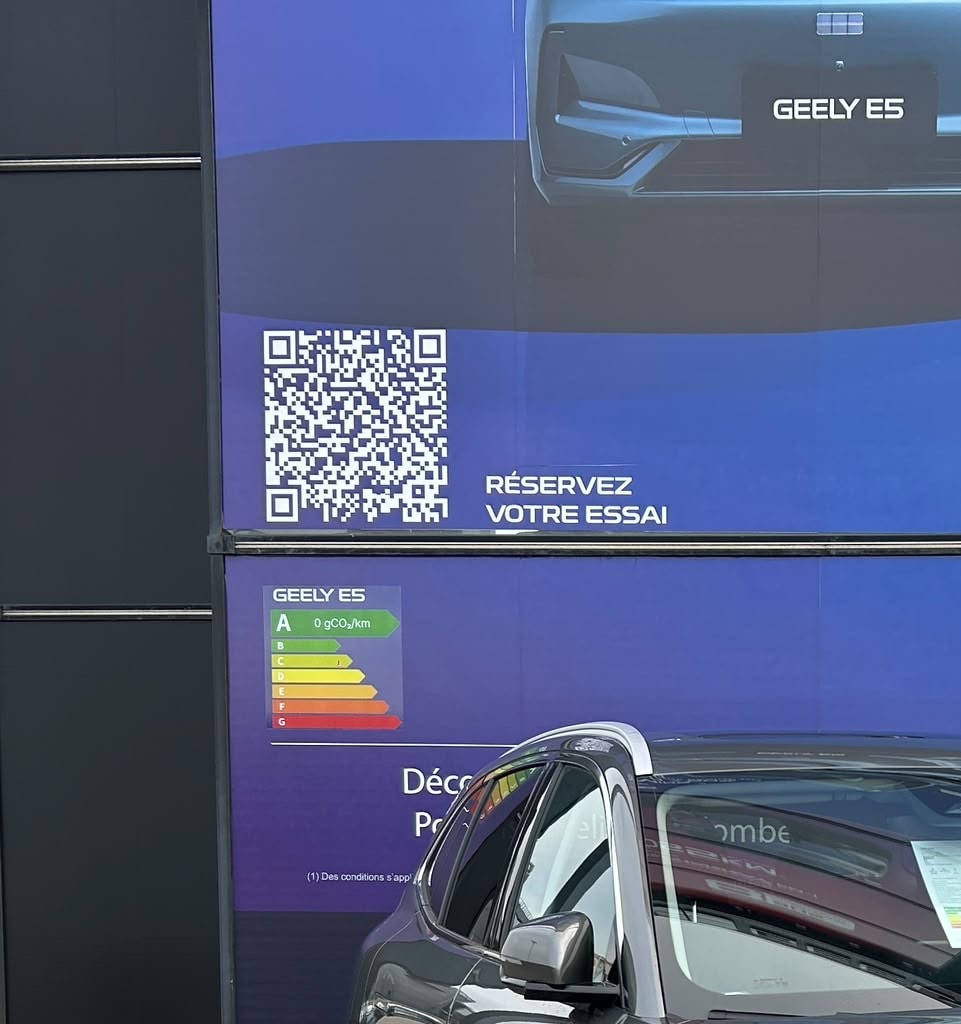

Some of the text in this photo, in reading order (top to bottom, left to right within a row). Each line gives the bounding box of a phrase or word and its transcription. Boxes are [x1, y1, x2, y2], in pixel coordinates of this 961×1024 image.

[773, 98, 905, 120] GEELY E5
[486, 471, 633, 497] RÉSERVEZ
[485, 504, 668, 526] VOTRE ESSAI
[272, 588, 367, 603] GEELY E5
[276, 613, 292, 632] A
[314, 618, 322, 628] 0
[277, 641, 285, 651] B
[277, 656, 285, 667] C
[277, 671, 286, 682] D
[278, 686, 286, 697] E
[278, 702, 286, 712] F
[277, 717, 286, 727] G
[307, 871, 320, 883] (1)
[321, 871, 339, 882] Des
[340, 871, 385, 882] conditions
